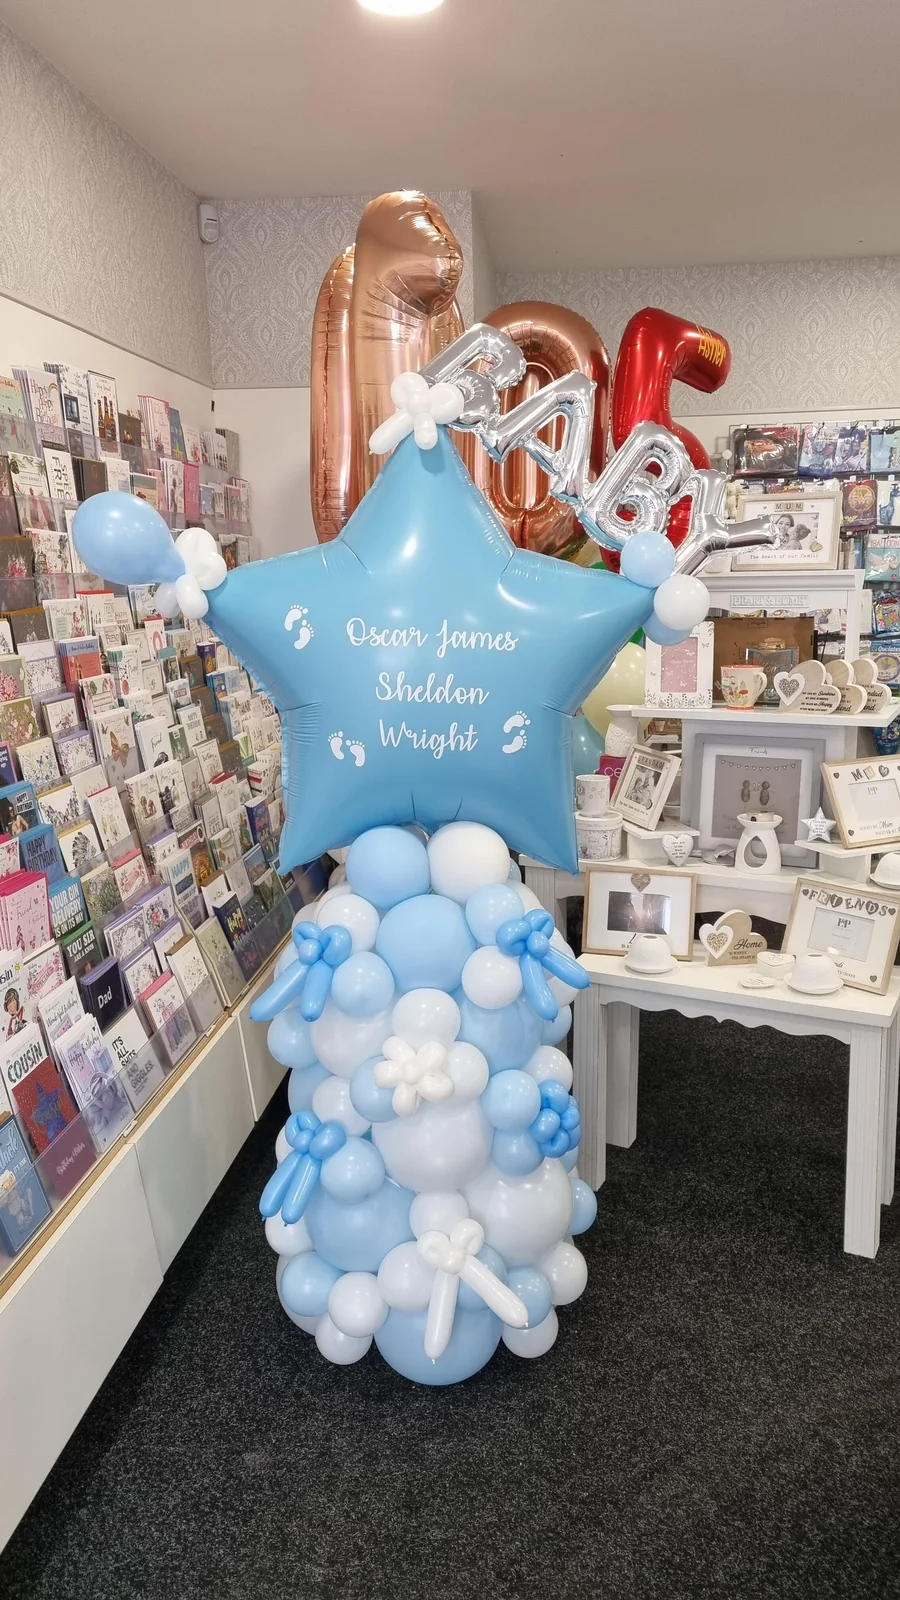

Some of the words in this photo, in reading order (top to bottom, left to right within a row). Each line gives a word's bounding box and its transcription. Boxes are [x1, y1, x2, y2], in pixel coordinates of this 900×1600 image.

[696, 324, 727, 367] Asher
[420, 323, 780, 576] BABY
[52, 456, 65, 500] FRIE
[775, 502, 802, 511] MUM
[346, 617, 428, 647] Oscar
[436, 619, 519, 658] James
[375, 671, 490, 705] Sheldon
[379, 719, 479, 760] Wright
[16, 792, 28, 802] HAPPY
[16, 801, 33, 813] BIRTHDAY
[26, 834, 46, 857] HAPPY
[27, 847, 58, 872] BIRTHDAY
[171, 856, 190, 878] HAPPY
[49, 890, 68, 913] YOUR
[67, 883, 80, 900] GIN
[809, 890, 888, 916] FRIENDS
[52, 899, 81, 928] DELIVERY
[54, 927, 61, 938] IS
[60, 924, 68, 935] ON
[75, 912, 84, 924] WAY
[66, 937, 82, 958] YOU
[82, 929, 95, 946] SIR
[734, 939, 763, 950] Home
[0, 969, 13, 984] sin
[97, 985, 112, 1009] Dad
[112, 1036, 123, 1051] IT'S
[117, 1046, 129, 1061] ALL
[127, 1063, 139, 1079] AND
